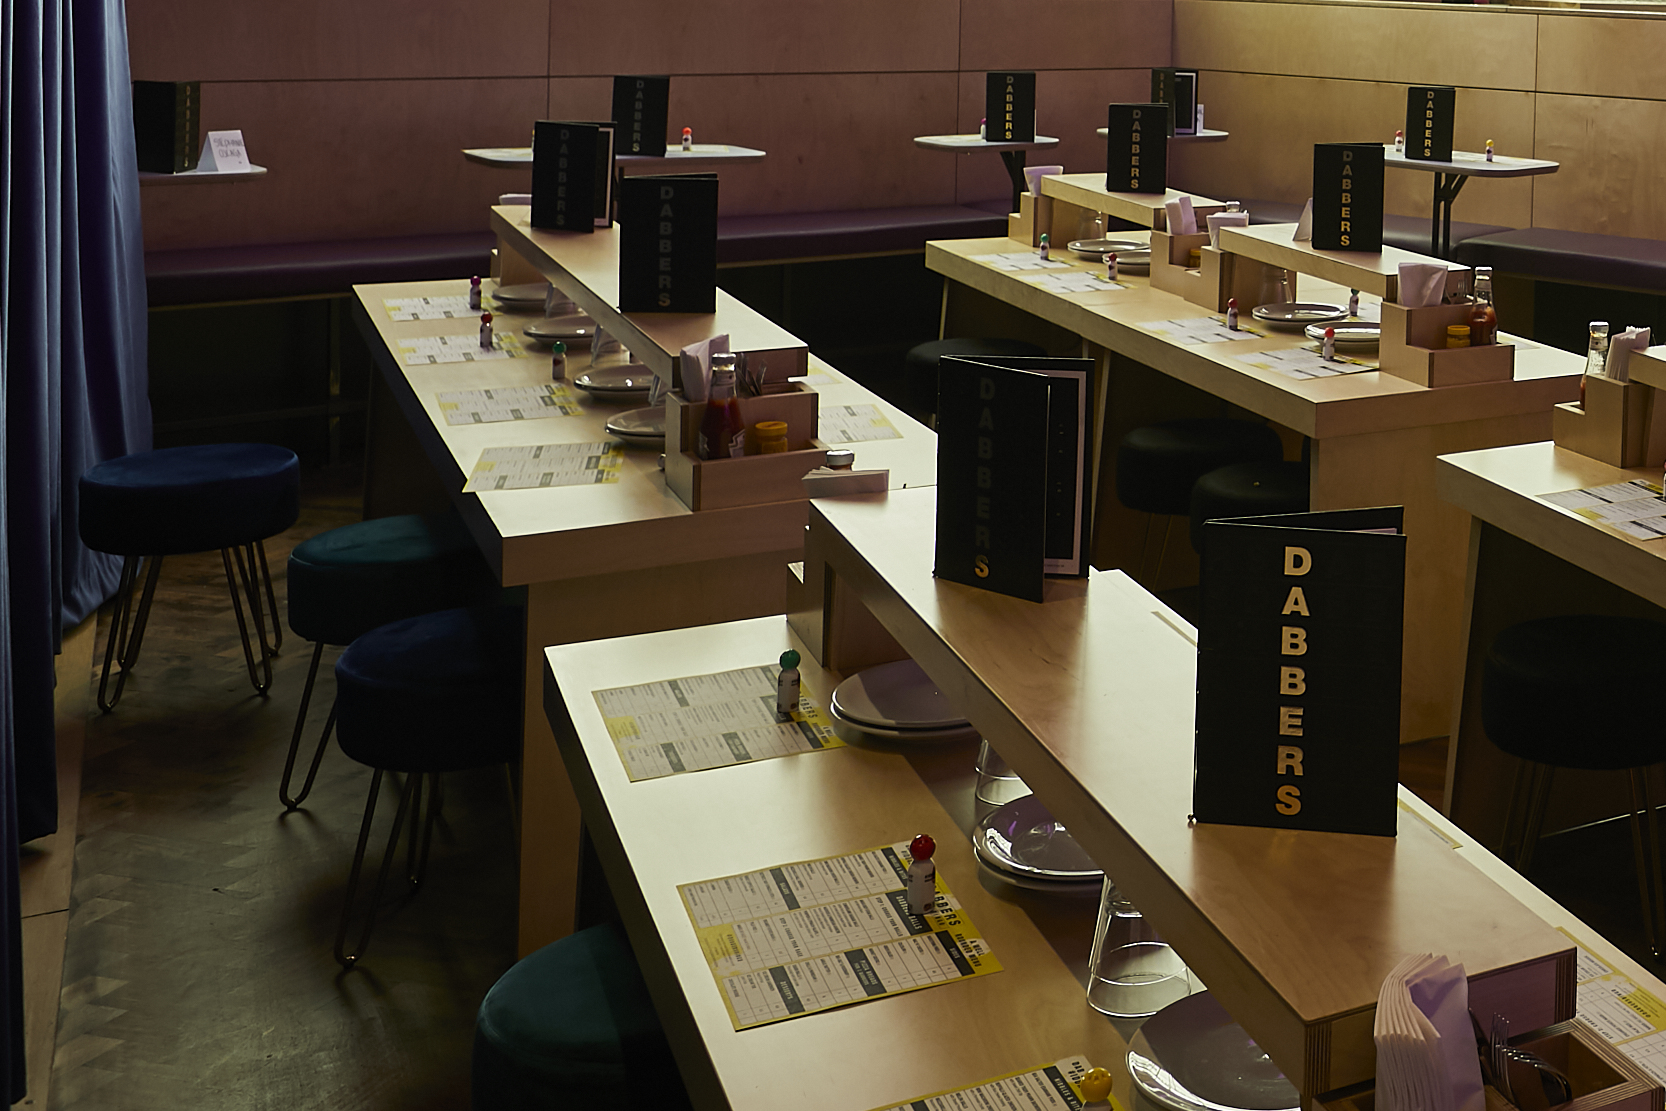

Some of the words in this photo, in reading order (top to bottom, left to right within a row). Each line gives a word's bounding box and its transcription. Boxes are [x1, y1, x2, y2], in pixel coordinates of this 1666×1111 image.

[631, 79, 644, 153] DABBERS
[1005, 74, 1014, 140] DABBERS
[1129, 109, 1142, 190] DABBERS
[1423, 90, 1435, 158] DABBERS
[555, 128, 571, 227] DABBERS
[1339, 149, 1353, 248] DABBERS
[659, 185, 675, 309] DABBERS
[974, 377, 996, 579] DABBERS
[1275, 545, 1313, 817] DABBERS
